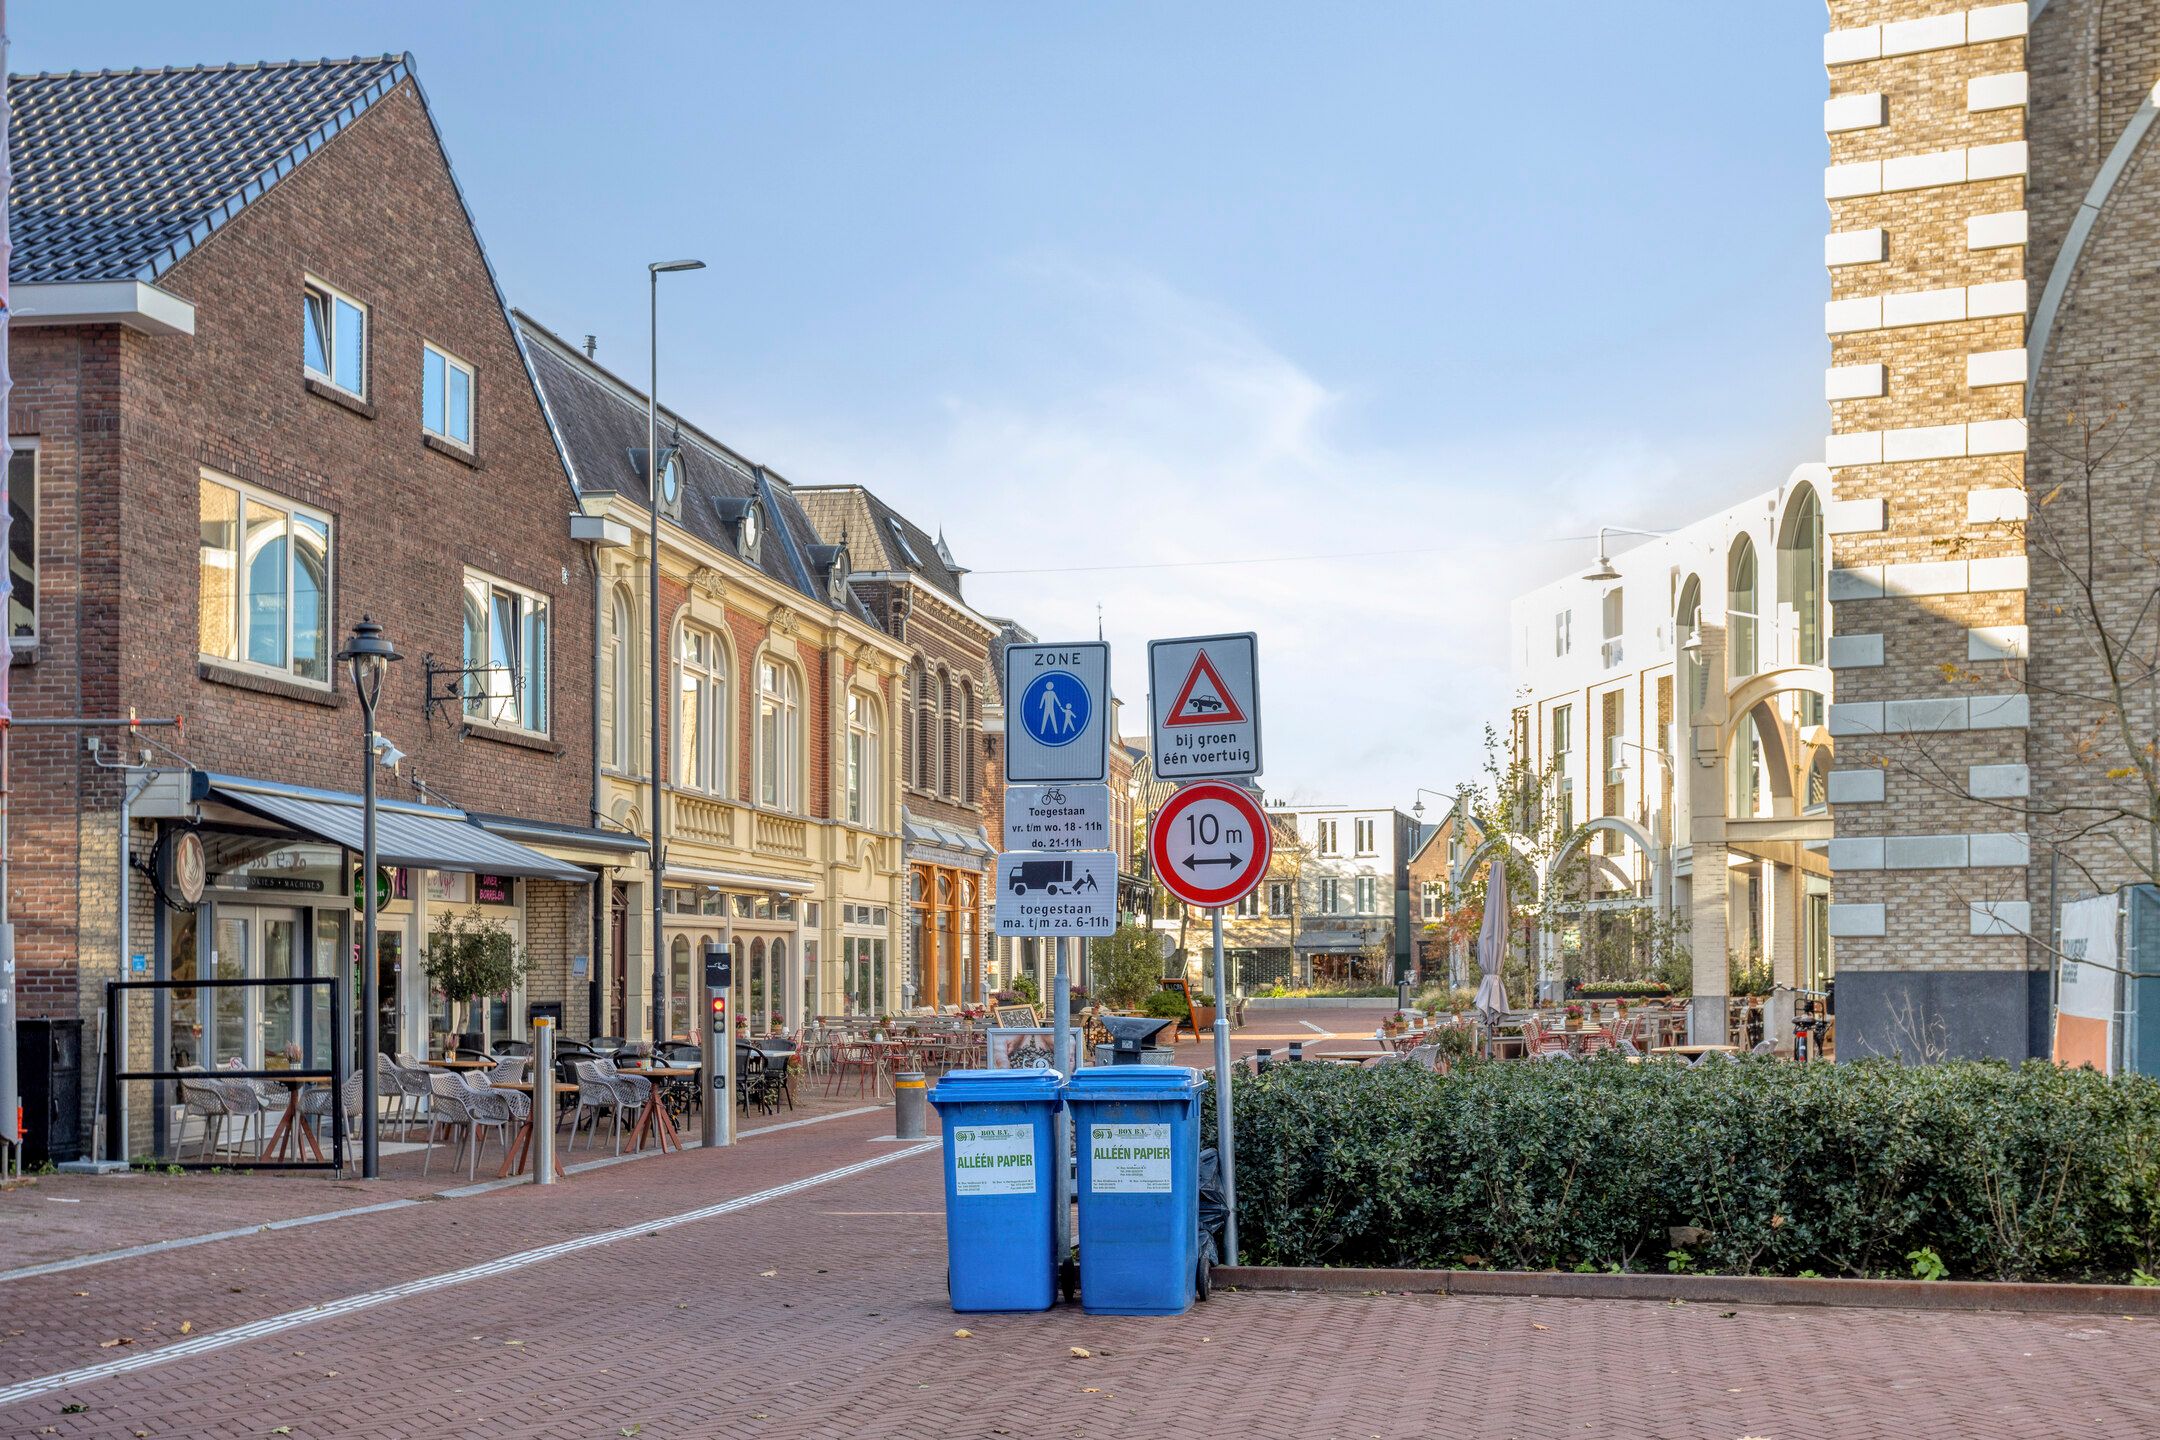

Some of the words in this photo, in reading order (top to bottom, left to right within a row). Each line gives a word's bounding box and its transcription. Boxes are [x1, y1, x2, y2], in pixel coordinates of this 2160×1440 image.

[1035, 653, 1081, 666] ZONE
[1176, 734, 1193, 749] bij
[1198, 733, 1237, 748] groen
[1163, 752, 1188, 765] één
[1192, 749, 1250, 763] voertuig
[1028, 807, 1085, 818] Toegestaan
[1026, 824, 1042, 832] t/m
[1064, 822, 1076, 831] 18
[1084, 822, 1102, 831] 11h
[1186, 813, 1219, 845] 10
[1226, 829, 1242, 843] m
[1031, 839, 1046, 848] do.
[1049, 839, 1082, 848] 21-11h
[1020, 904, 1092, 917] toegestaan
[1003, 919, 1024, 929] ma.
[1029, 917, 1050, 930] t/m
[1054, 919, 1072, 927] za.
[1076, 916, 1109, 928] 6-11h
[1093, 1144, 1131, 1160] ALLÉÉN
[1133, 1147, 1170, 1160] PAPIER
[957, 1152, 994, 1169] ALLÉÉN
[997, 1154, 1033, 1168] PAPIER
